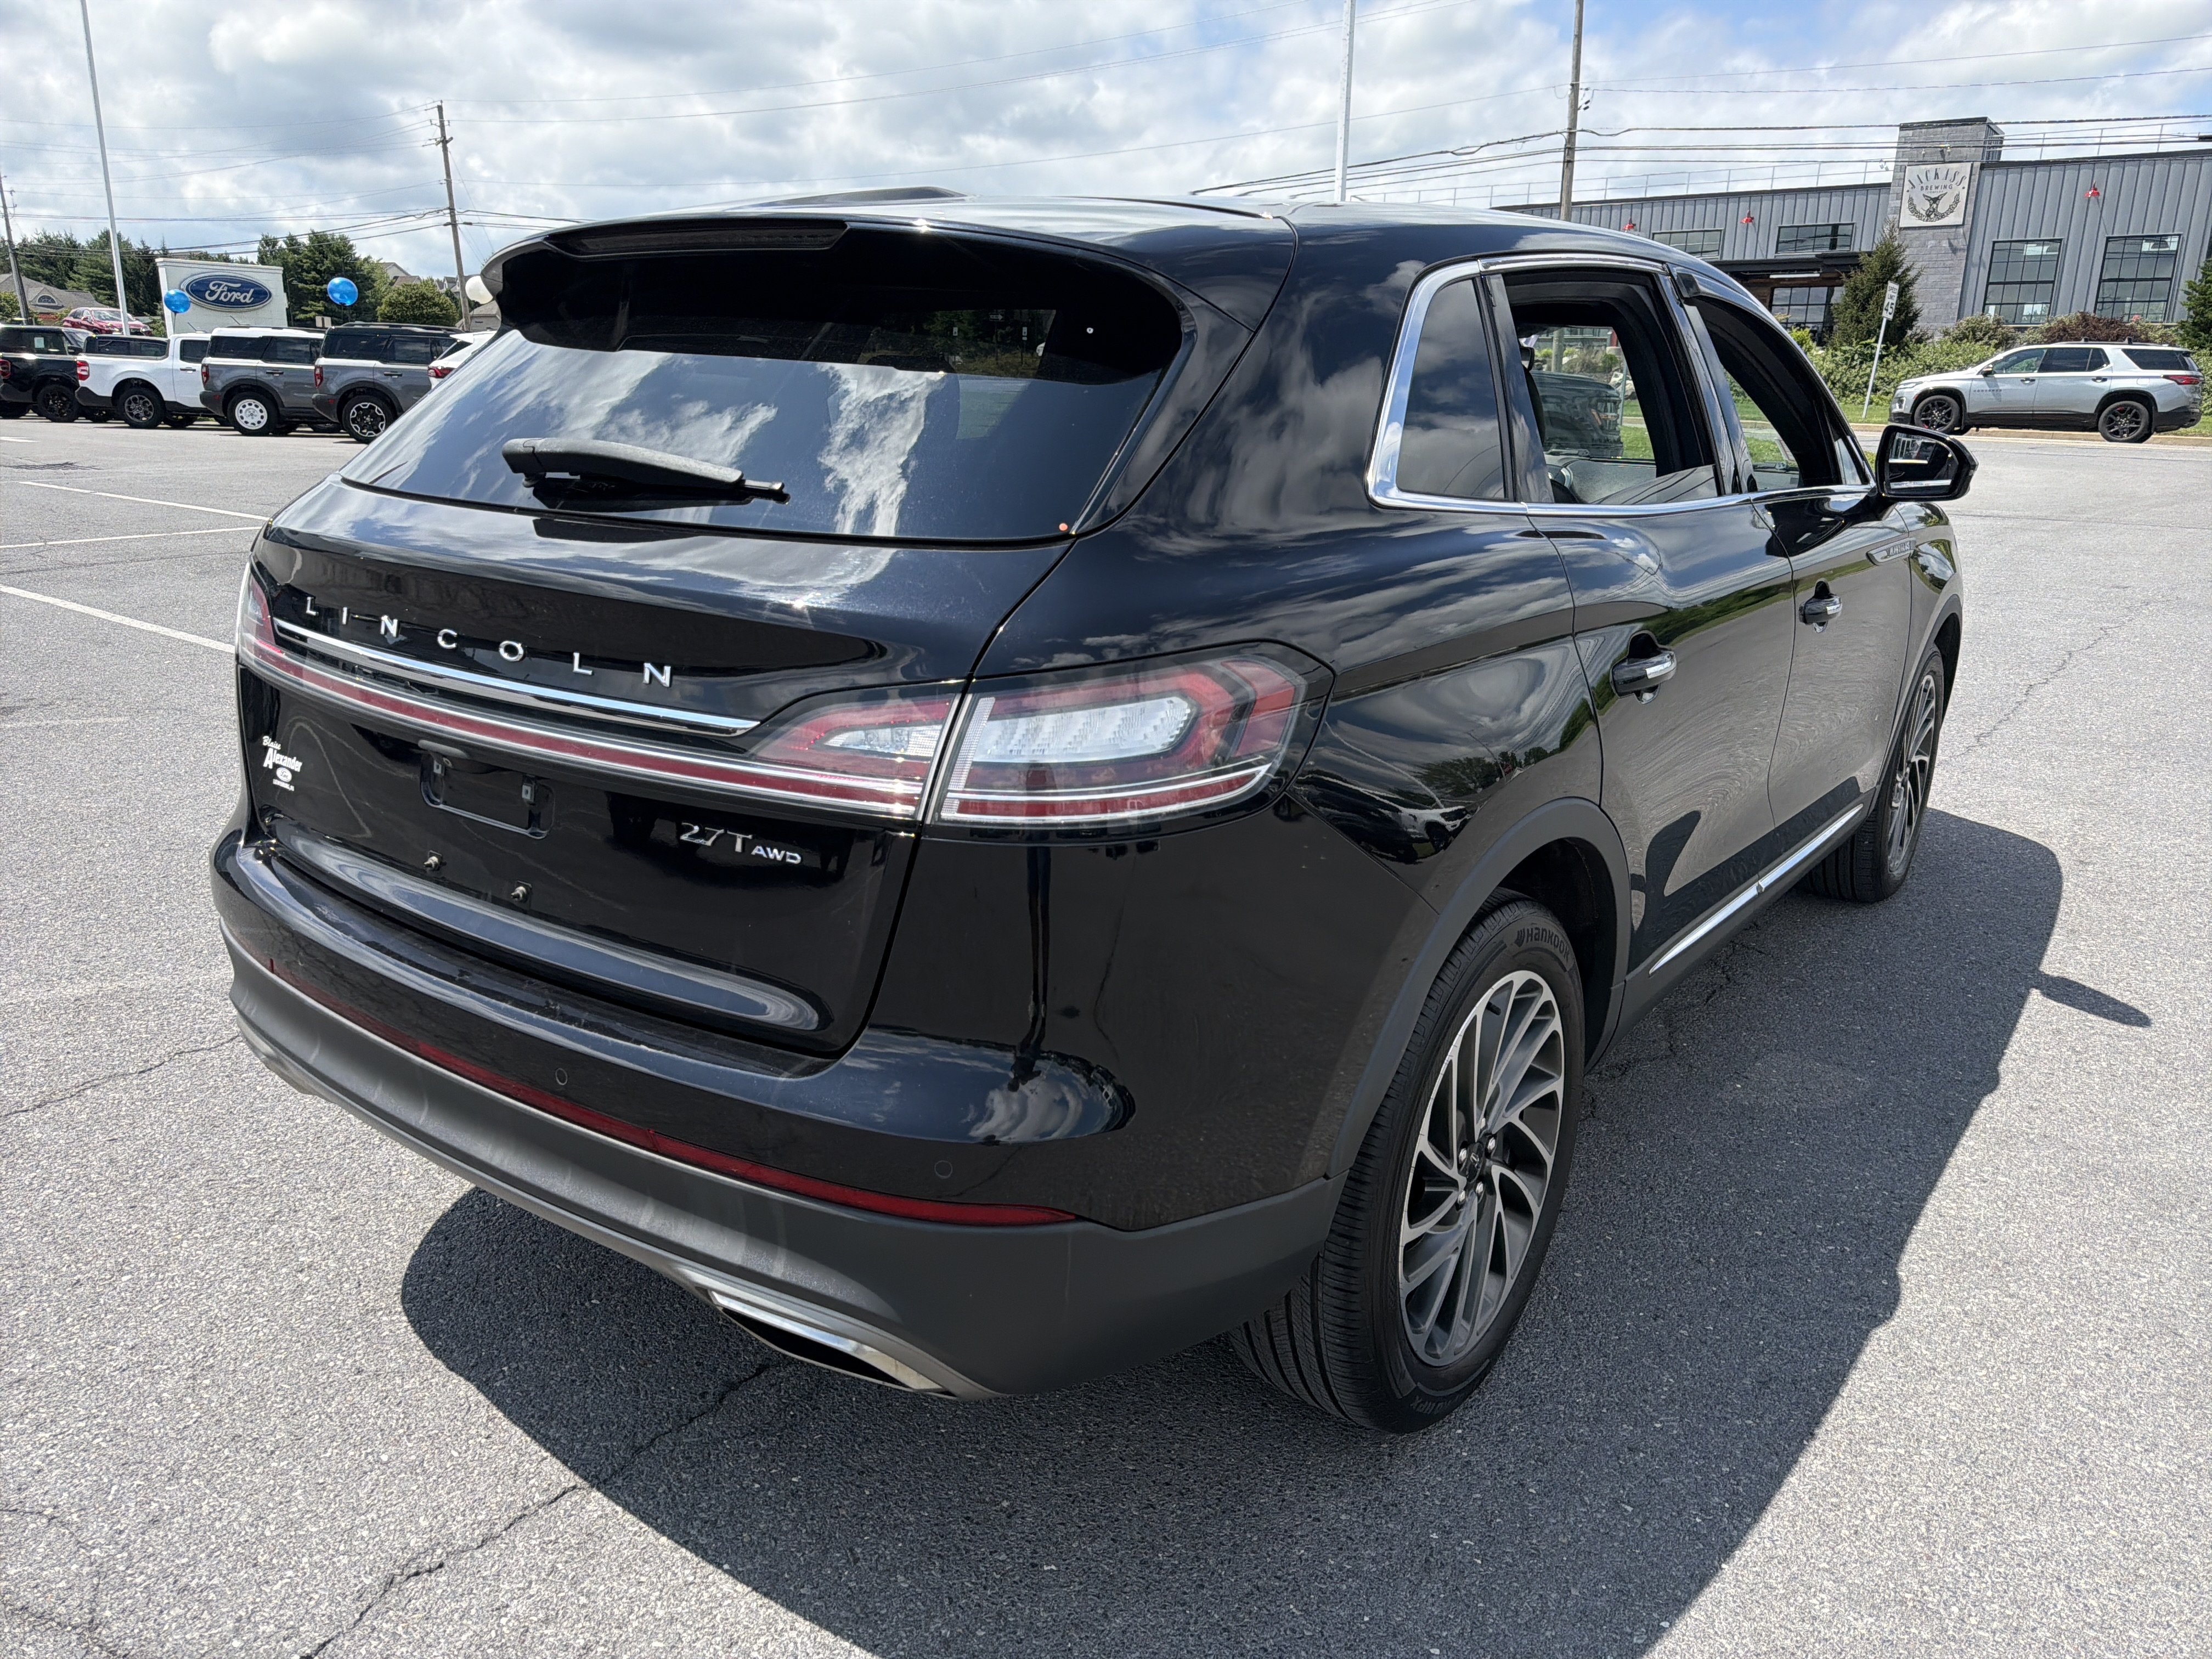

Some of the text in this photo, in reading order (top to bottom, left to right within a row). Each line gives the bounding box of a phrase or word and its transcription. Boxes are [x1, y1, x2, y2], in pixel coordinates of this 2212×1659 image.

[205, 280, 254, 303] Ford
[1884, 301, 1894, 315] 45
[306, 596, 672, 688] LINCOLN
[263, 736, 281, 750] Blaise
[263, 747, 303, 772] Alexander
[751, 845, 802, 864] AWD
